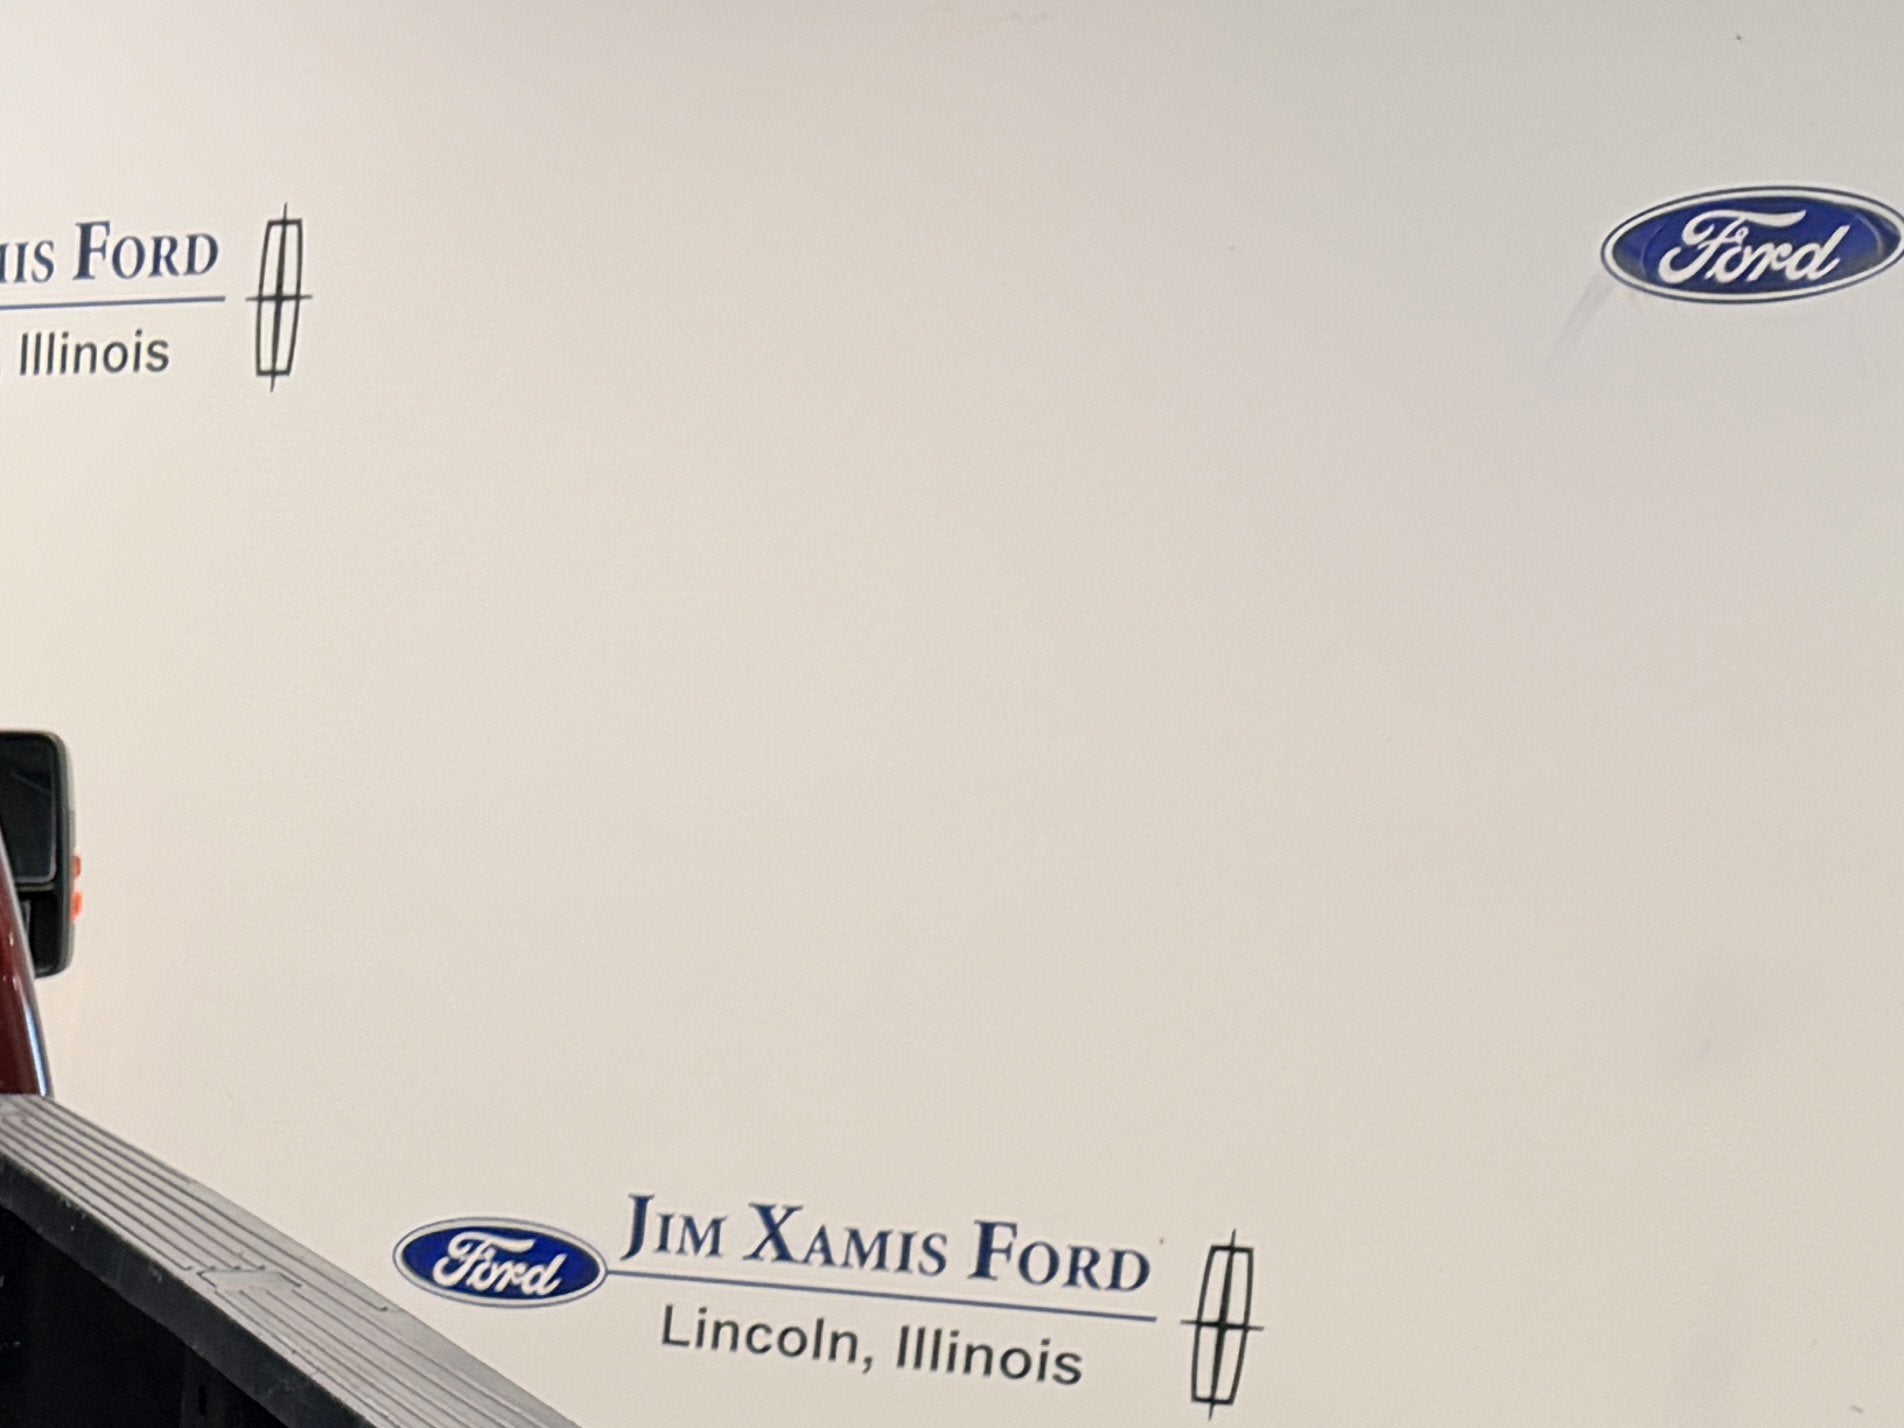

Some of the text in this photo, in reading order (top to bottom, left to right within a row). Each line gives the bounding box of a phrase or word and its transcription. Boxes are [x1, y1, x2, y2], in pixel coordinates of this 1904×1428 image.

[73, 220, 219, 281] FORD
[1658, 209, 1850, 284] Ford
[19, 329, 169, 375] Illinois
[434, 1233, 566, 1297] Ford
[620, 1194, 1150, 1292] JIM XAMIS FORD
[661, 1304, 1082, 1386] Lincoln, Illinois
